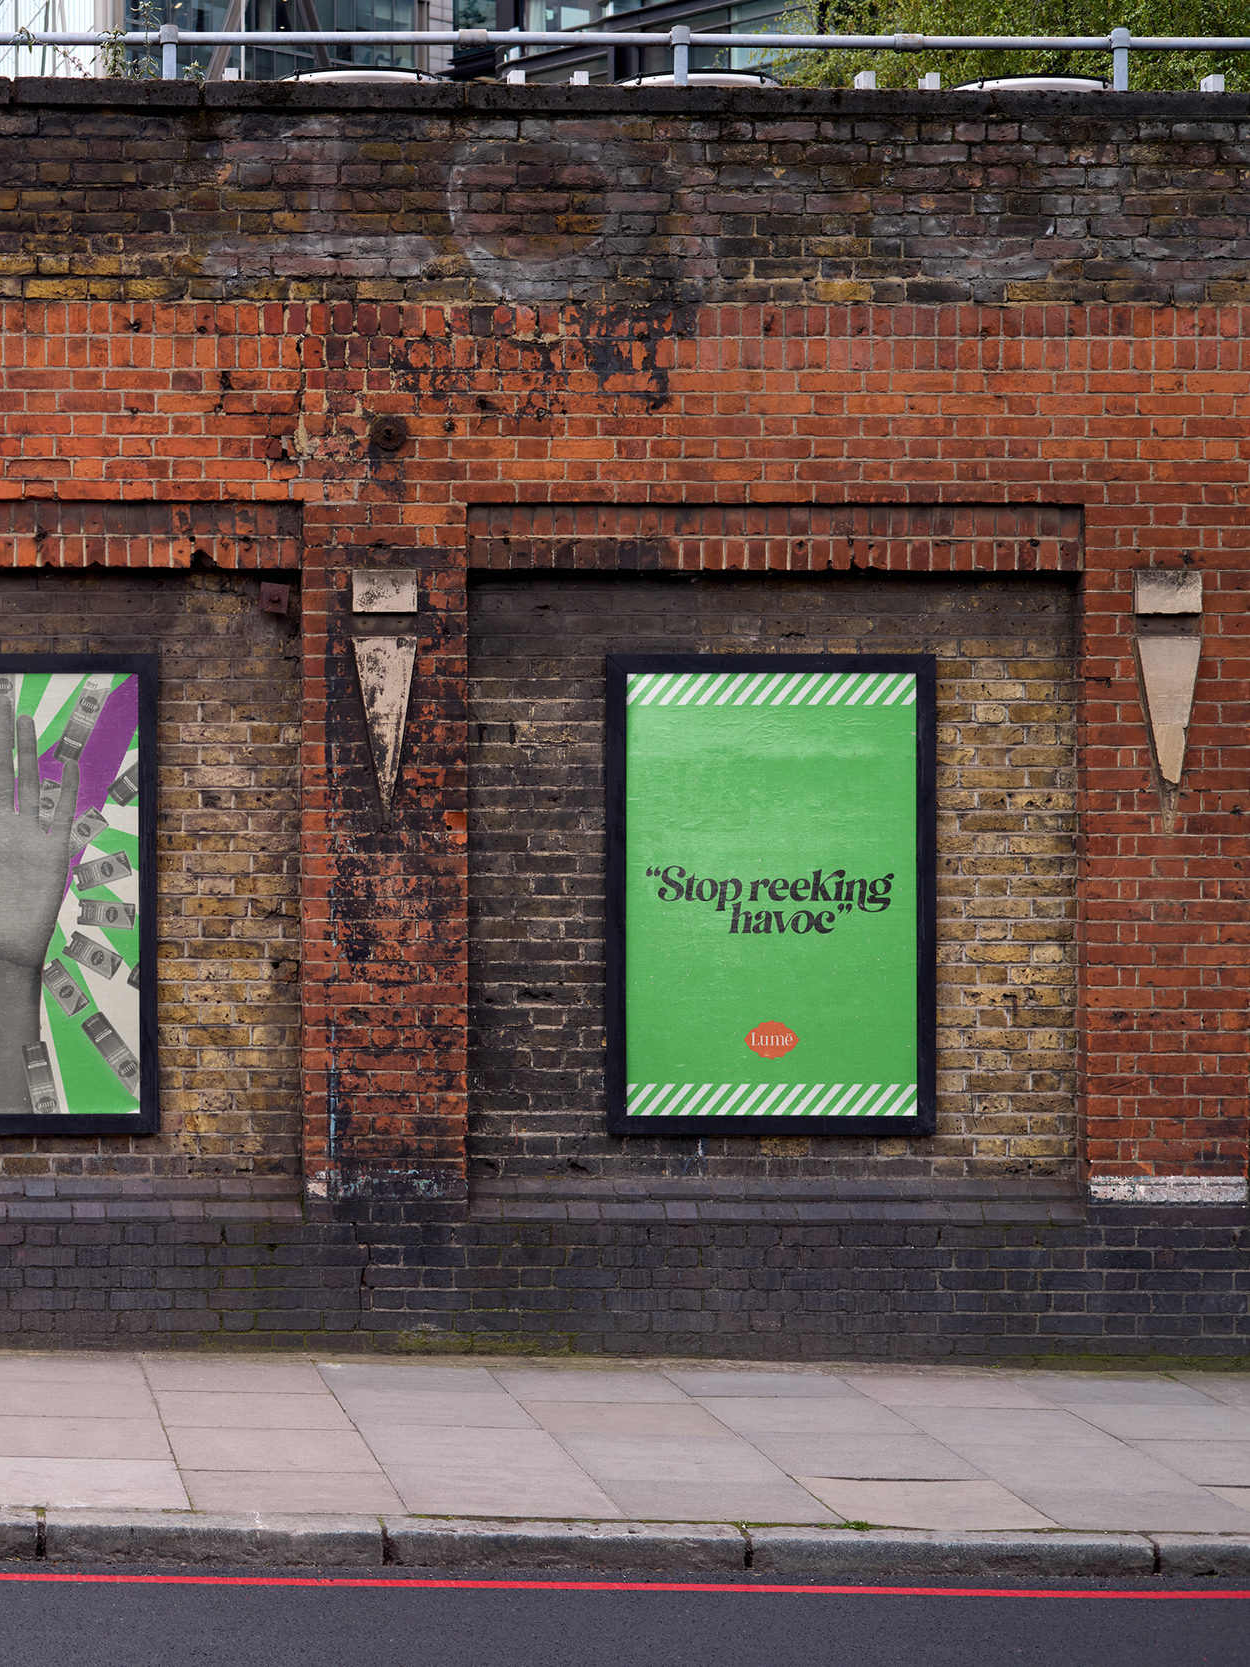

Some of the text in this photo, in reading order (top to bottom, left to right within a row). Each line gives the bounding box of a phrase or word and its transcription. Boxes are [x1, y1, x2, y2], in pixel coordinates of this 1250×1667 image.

[646, 866, 894, 913] “Stop reeking
[729, 902, 852, 934] havoc”
